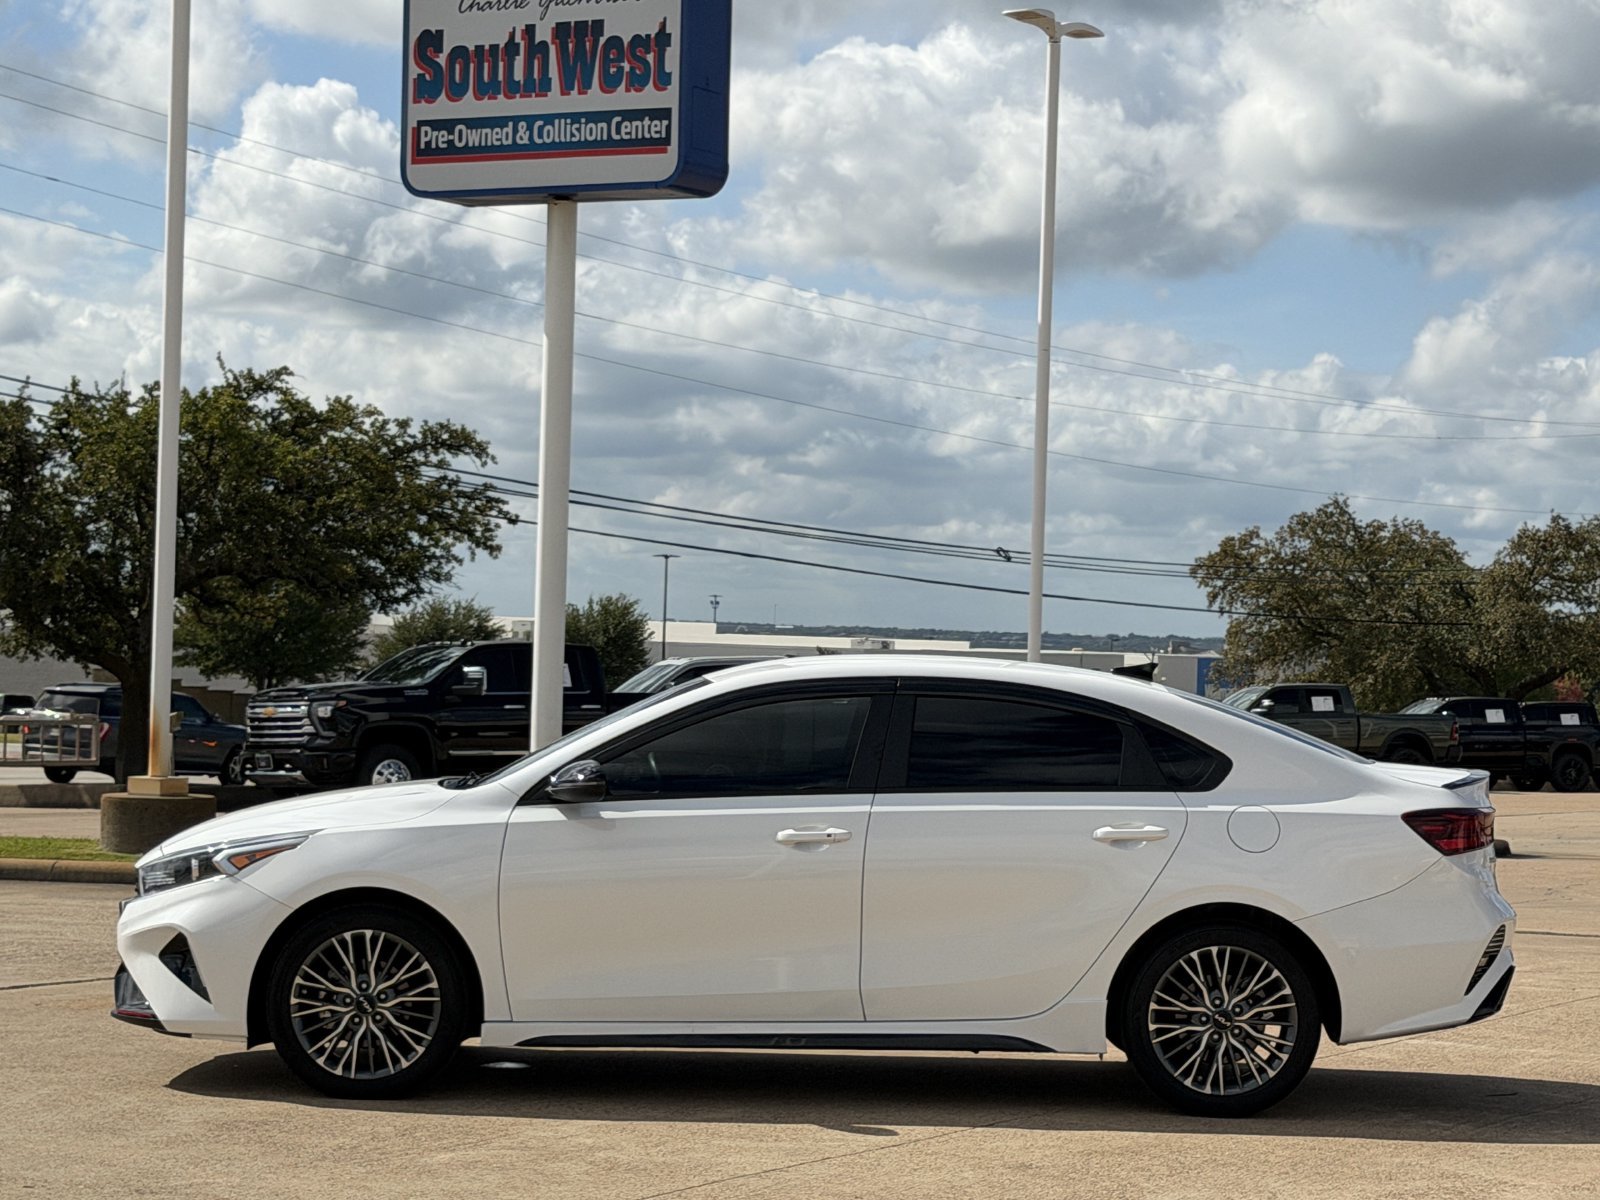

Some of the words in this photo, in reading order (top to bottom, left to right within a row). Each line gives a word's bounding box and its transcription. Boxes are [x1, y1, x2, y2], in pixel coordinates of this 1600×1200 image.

[420, 121, 513, 149] Pre-Owned
[516, 121, 530, 145] &
[533, 117, 607, 143] Collision
[610, 115, 669, 140] Center
